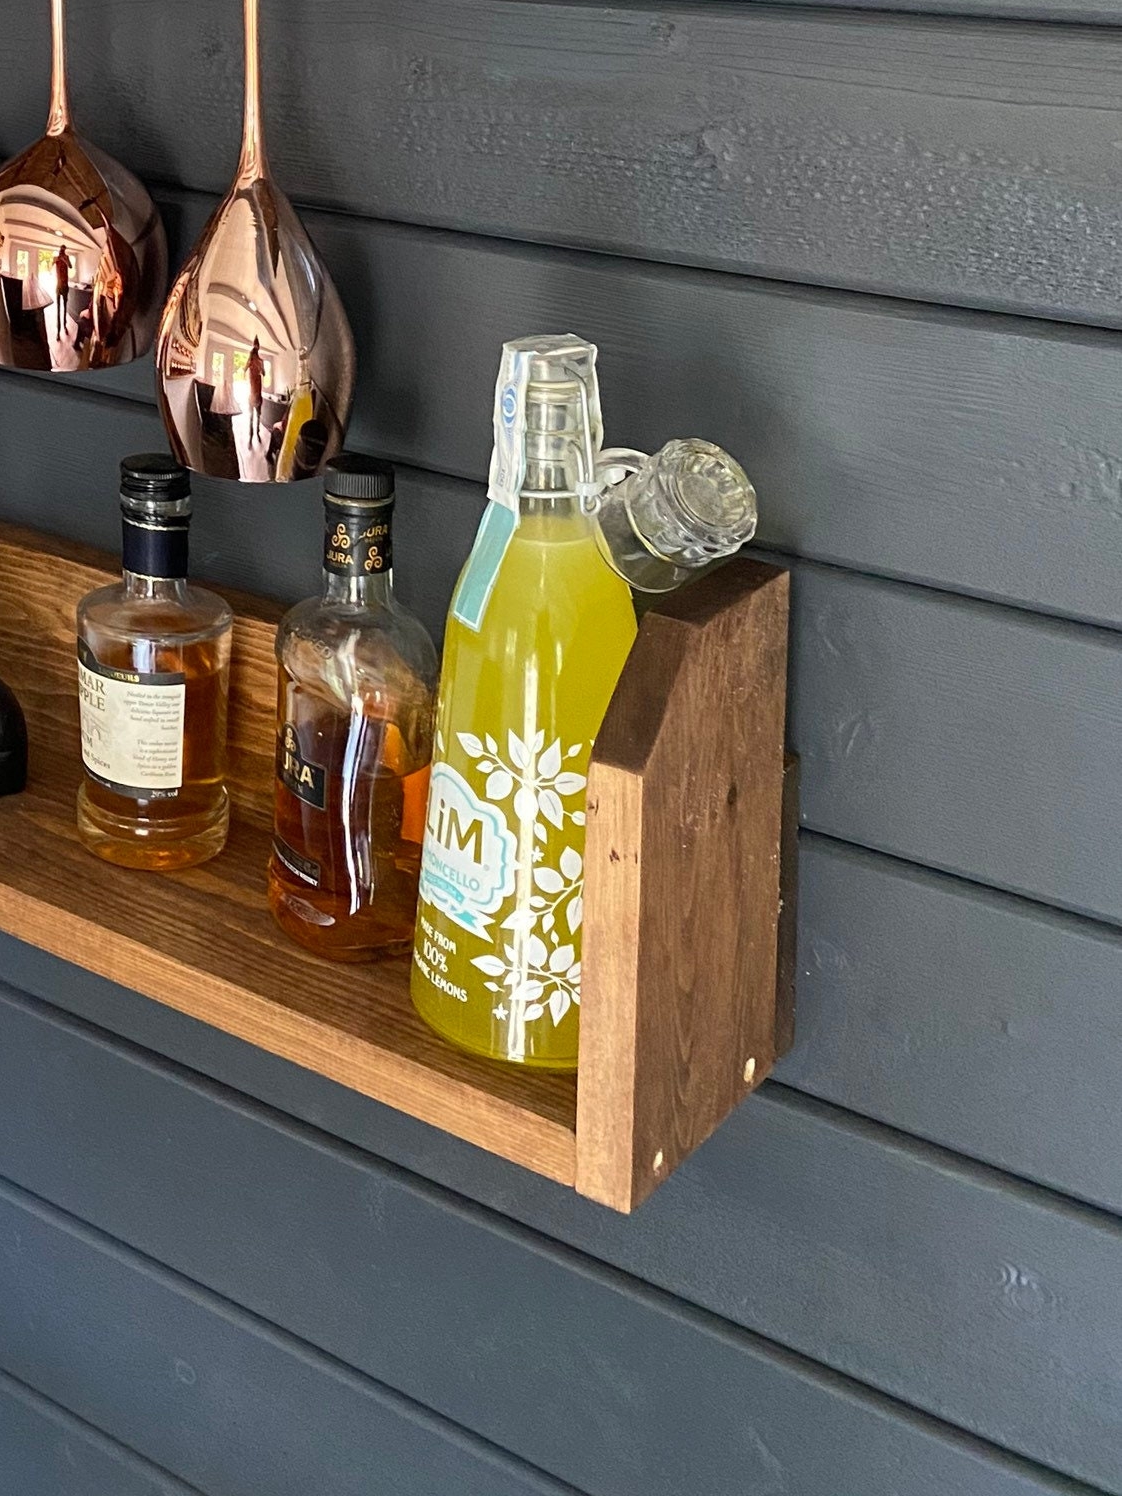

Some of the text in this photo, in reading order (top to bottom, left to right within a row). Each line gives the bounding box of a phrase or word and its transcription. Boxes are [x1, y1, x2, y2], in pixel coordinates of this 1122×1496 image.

[326, 550, 354, 565] JURA
[434, 930, 457, 955] FROM
[431, 971, 468, 1002] LEMONS
